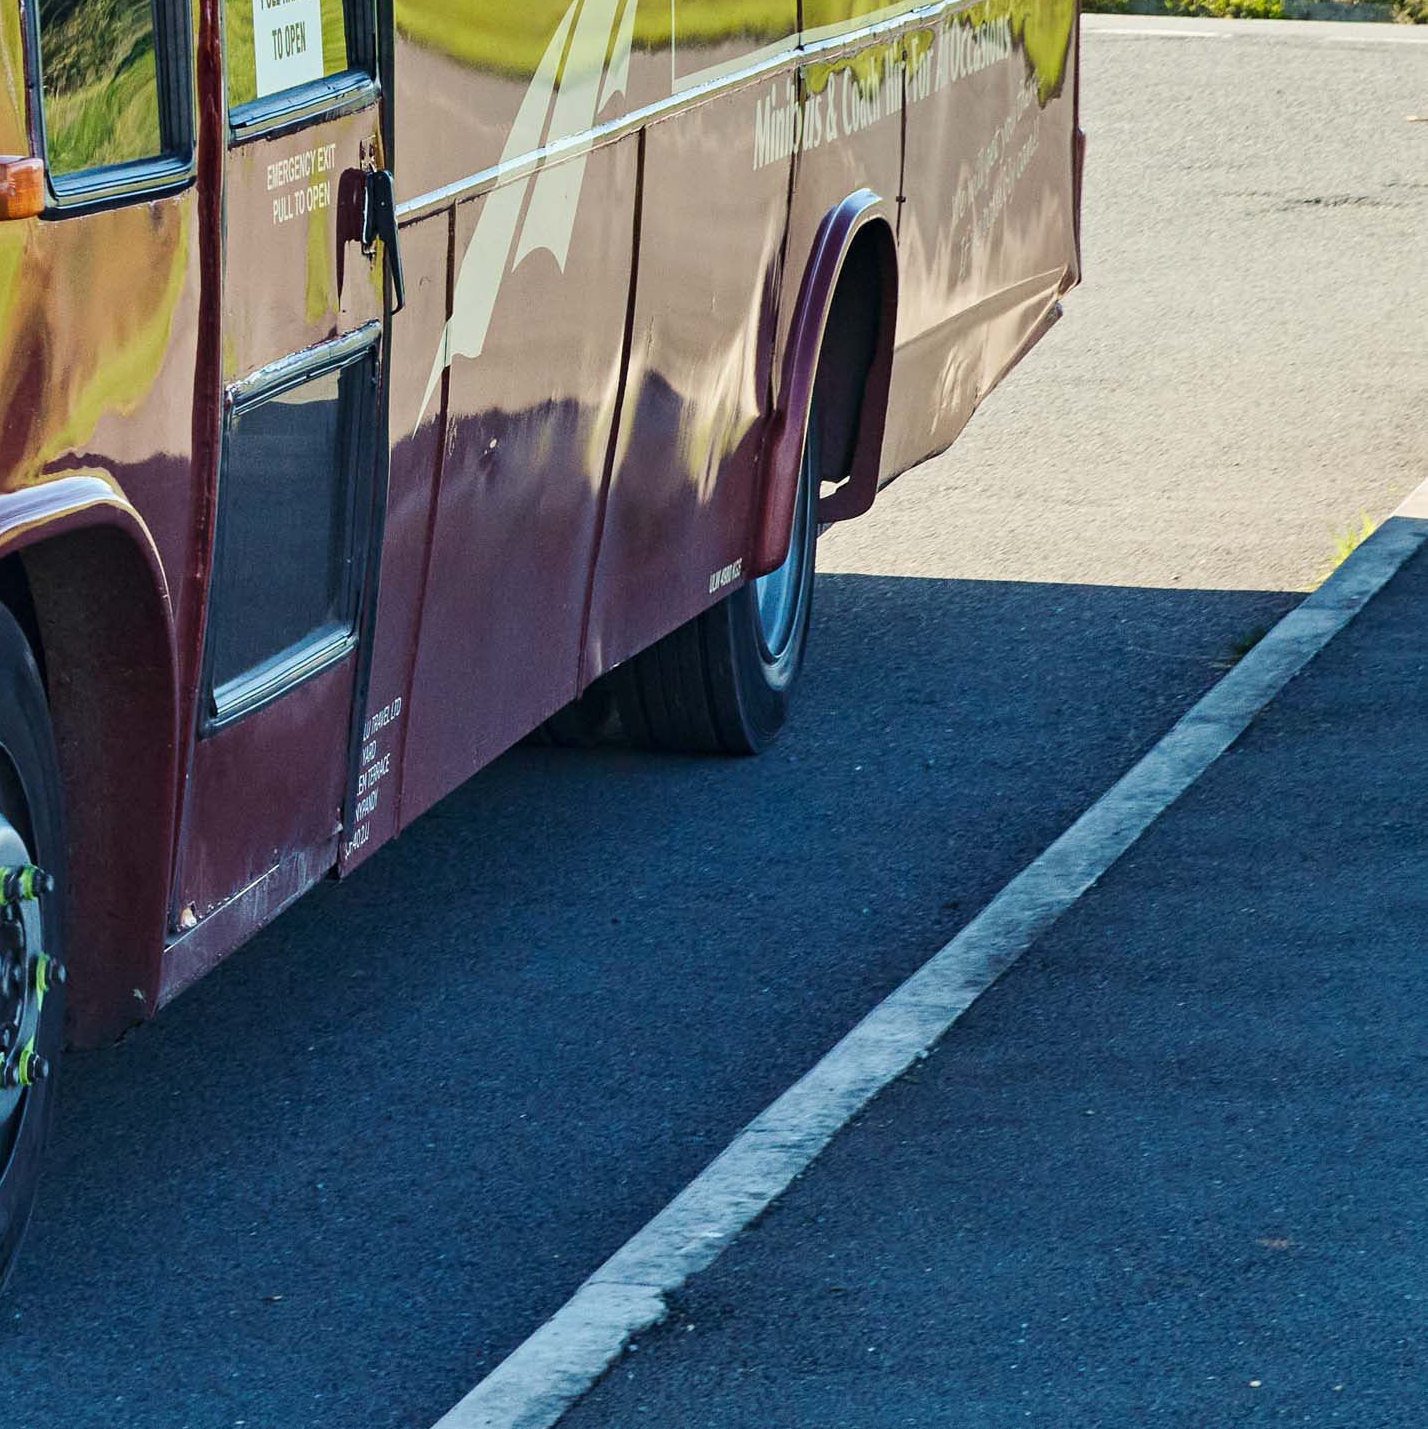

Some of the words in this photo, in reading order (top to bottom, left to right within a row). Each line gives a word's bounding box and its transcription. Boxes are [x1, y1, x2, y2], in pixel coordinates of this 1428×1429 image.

[271, 28, 283, 61] TO
[284, 21, 307, 58] OPEN
[753, 74, 823, 172] Minibus
[825, 71, 839, 143] &
[842, 56, 882, 136] Coach
[267, 149, 317, 191] EMERGENCY
[317, 143, 336, 173] EXIT
[273, 194, 294, 225] PULL
[294, 189, 305, 216] TO
[306, 179, 331, 212] OPEN
